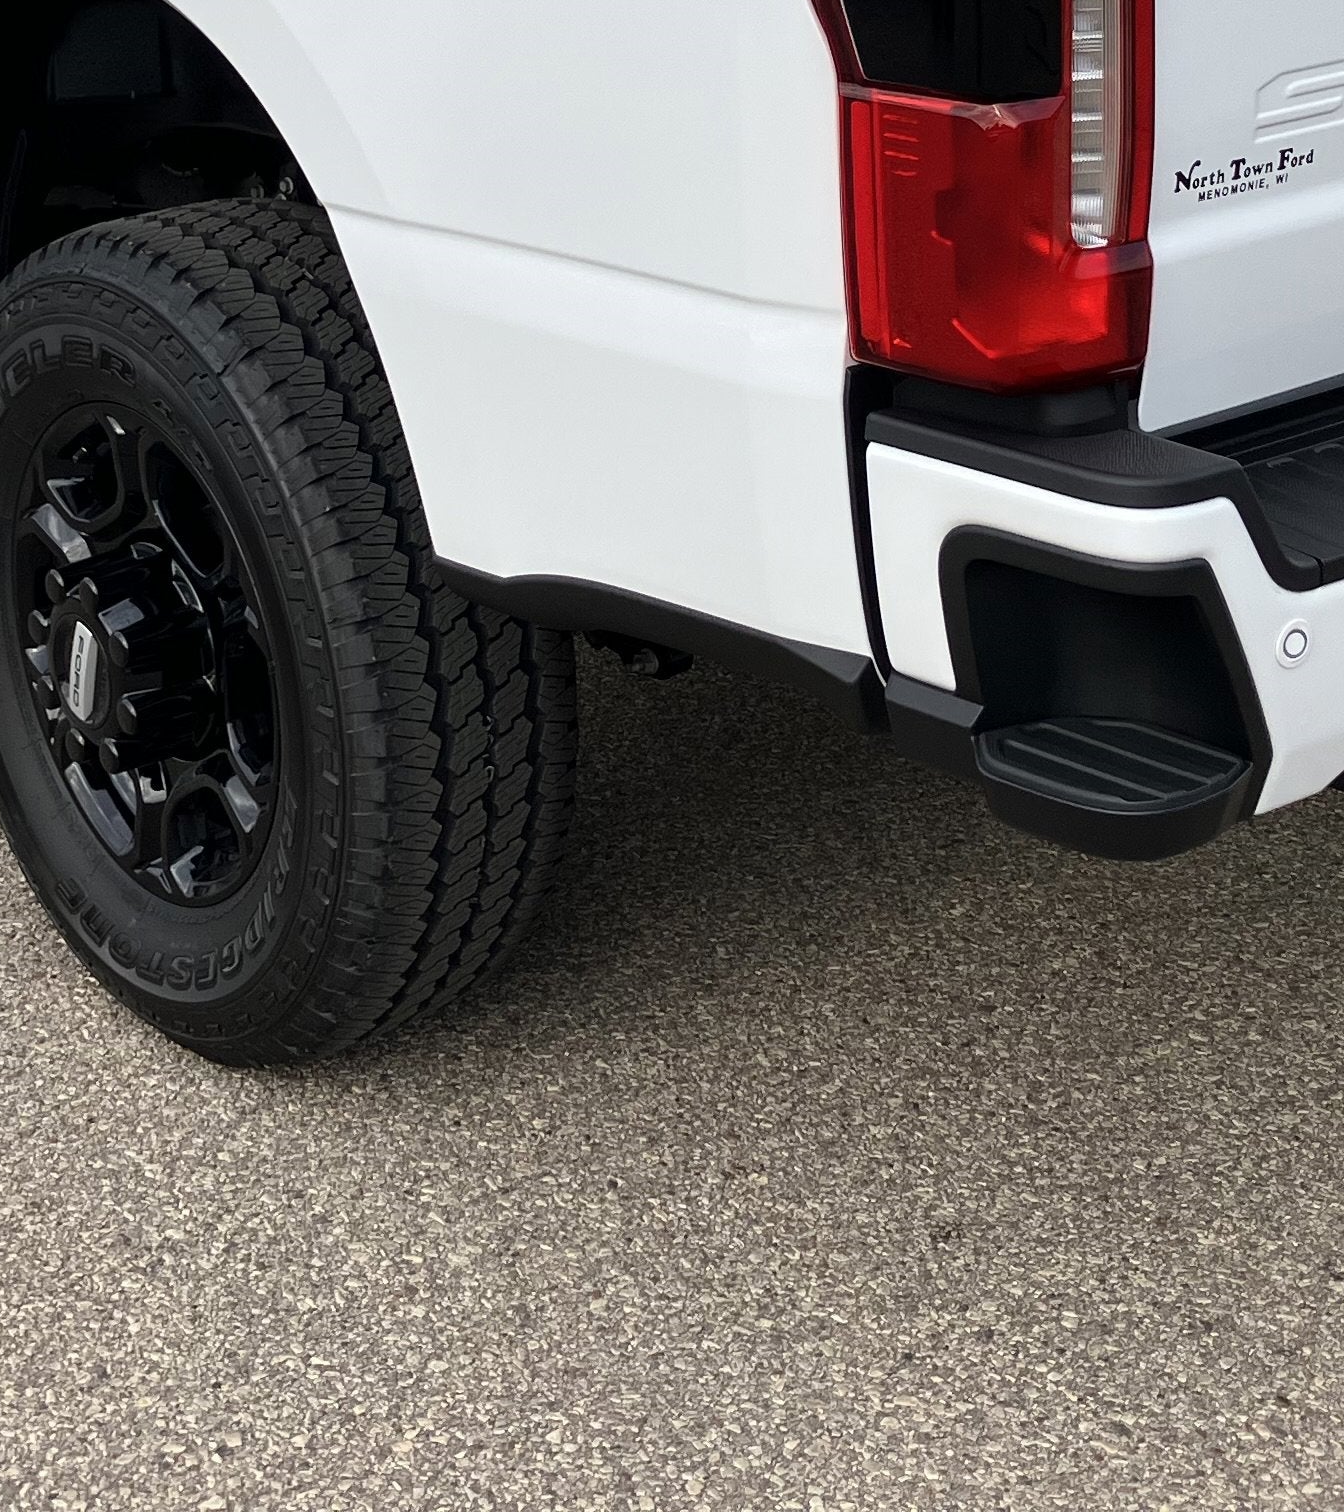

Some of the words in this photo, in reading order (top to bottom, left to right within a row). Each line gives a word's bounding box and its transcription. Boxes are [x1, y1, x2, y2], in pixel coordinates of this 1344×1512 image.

[1174, 159, 1225, 193] North
[1229, 157, 1273, 181] Town
[1277, 147, 1314, 171] Ford
[1197, 178, 1270, 202] MENOMONIE,
[1275, 172, 1289, 185] WI
[72, 634, 84, 708] FORD
